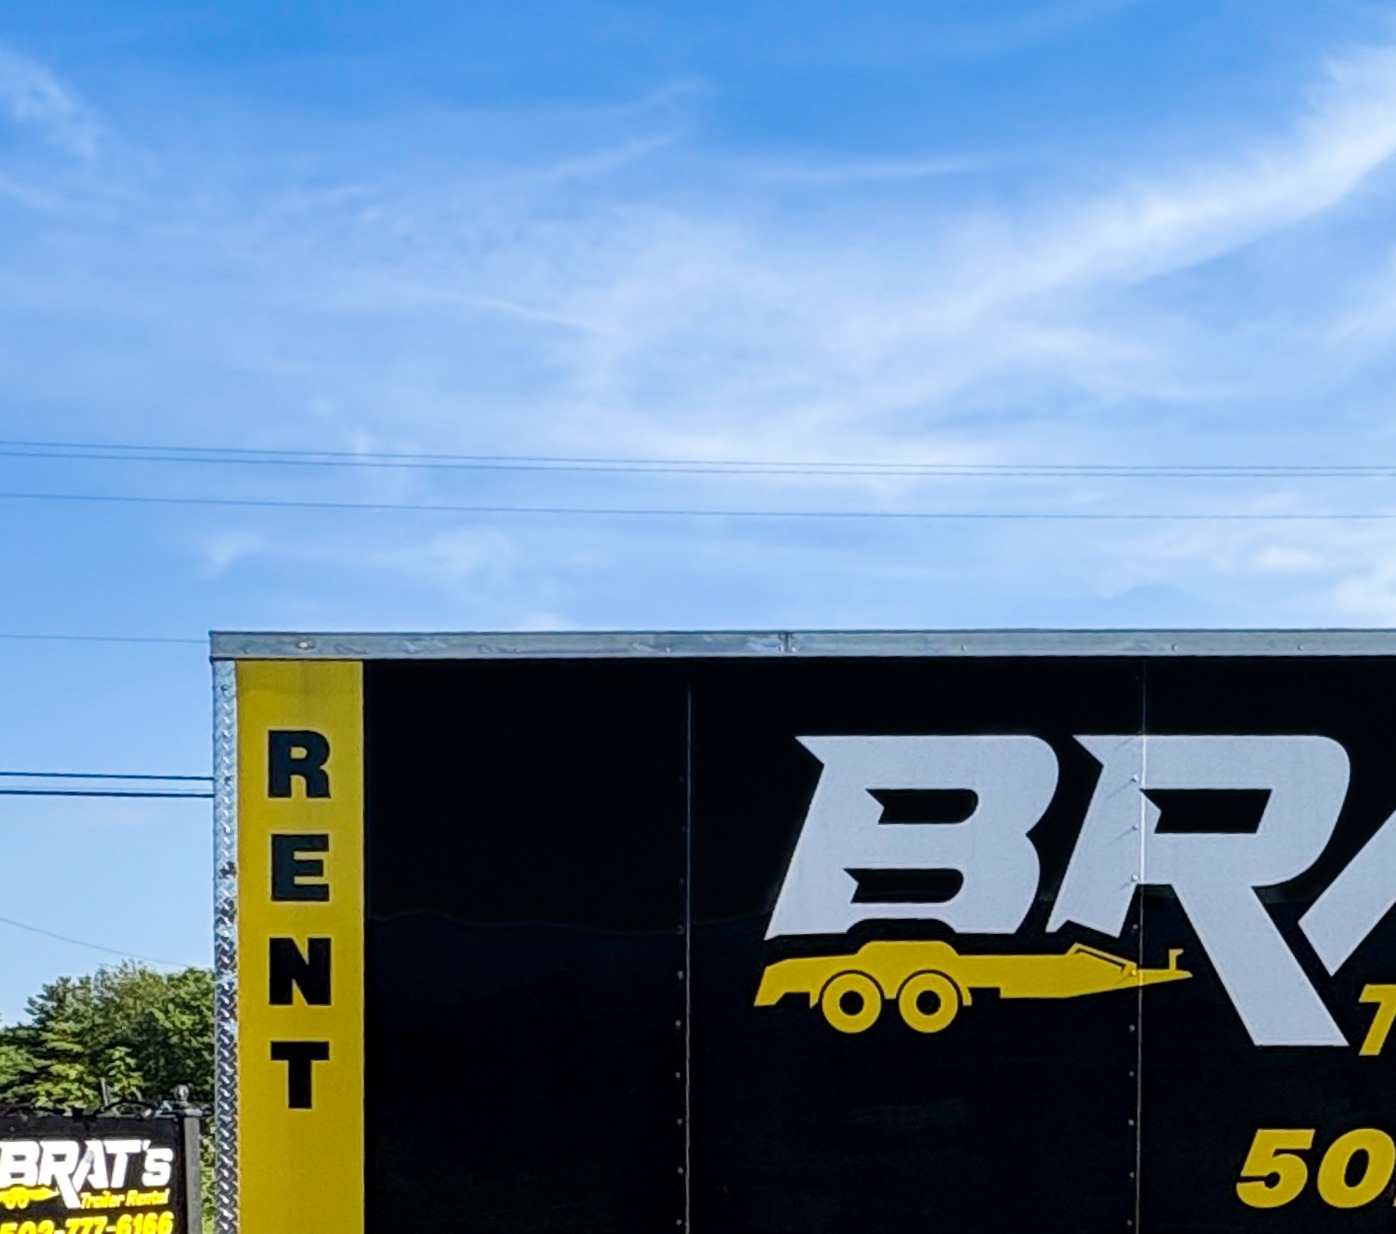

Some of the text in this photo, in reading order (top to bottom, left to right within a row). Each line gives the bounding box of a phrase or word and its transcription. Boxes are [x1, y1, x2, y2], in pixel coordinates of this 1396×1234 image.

[267, 729, 332, 1110] RENT
[0, 1139, 174, 1209] BRAT's
[80, 1187, 170, 1209] Trailer Rental
